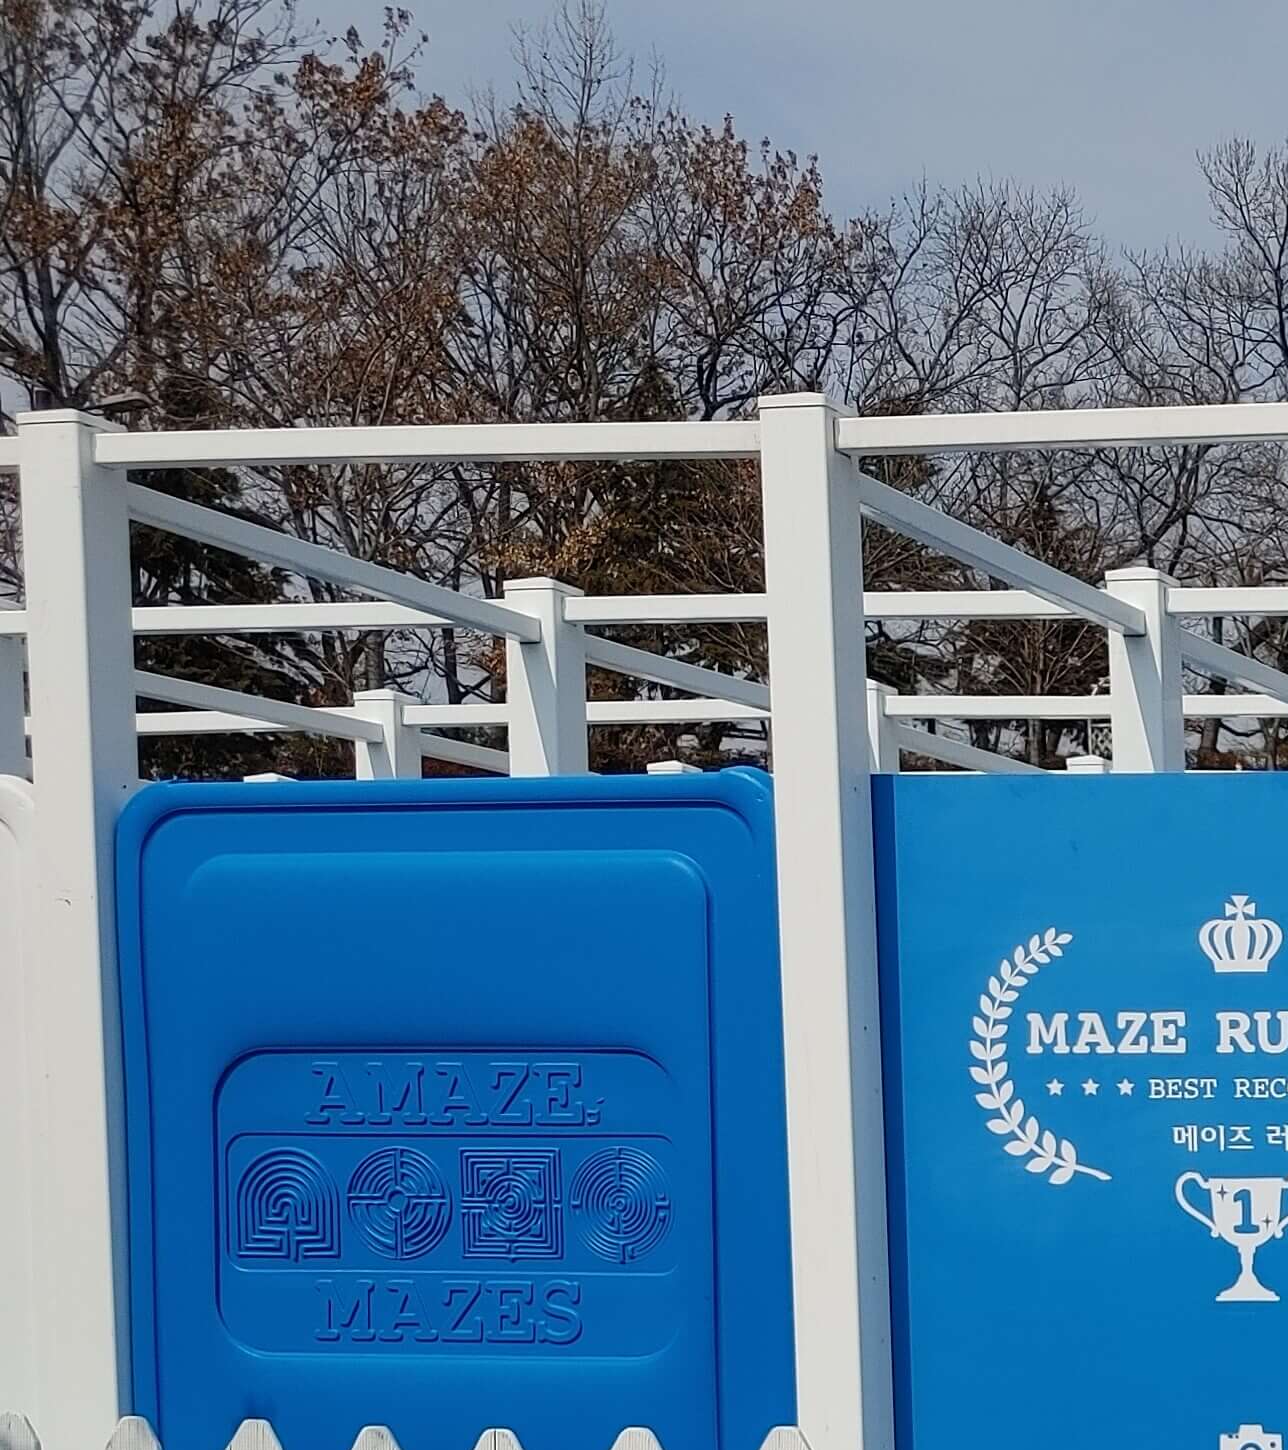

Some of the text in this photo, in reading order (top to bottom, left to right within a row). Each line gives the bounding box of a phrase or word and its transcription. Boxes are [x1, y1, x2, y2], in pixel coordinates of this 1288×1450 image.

[1025, 1011, 1188, 1054] MAZE
[1147, 1078, 1218, 1100] BEST
[1171, 1124, 1255, 1152] 메이즈
[314, 1280, 583, 1345] MAZES
